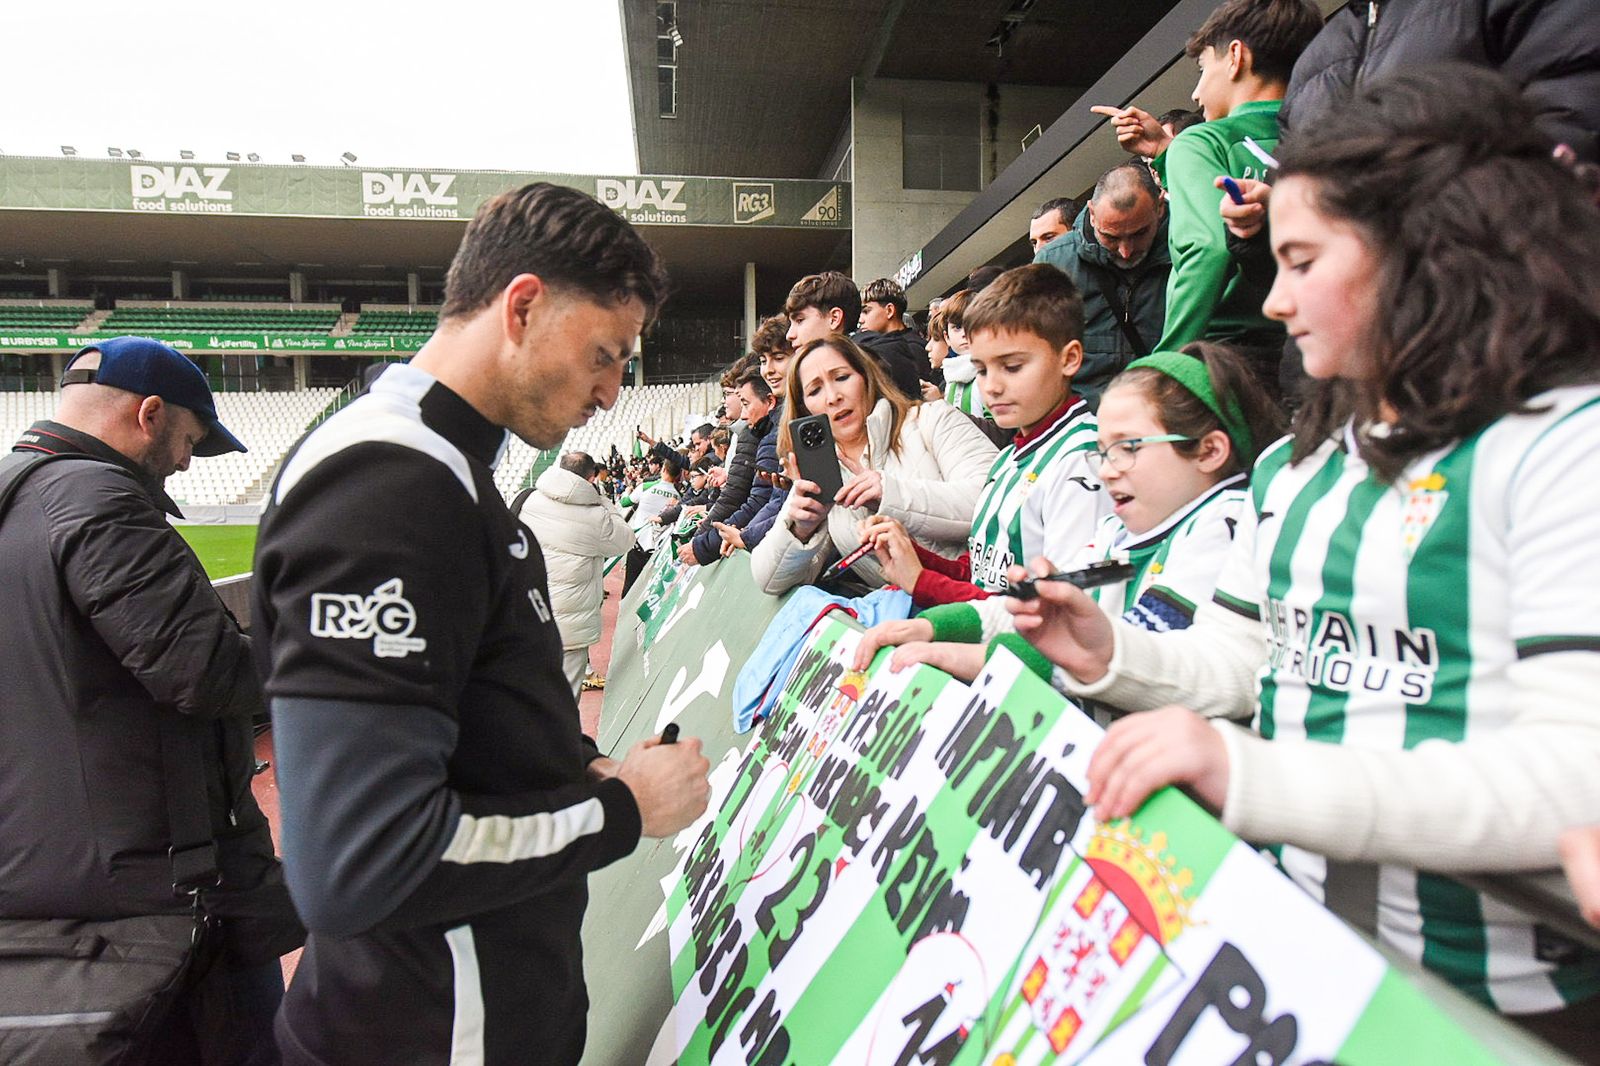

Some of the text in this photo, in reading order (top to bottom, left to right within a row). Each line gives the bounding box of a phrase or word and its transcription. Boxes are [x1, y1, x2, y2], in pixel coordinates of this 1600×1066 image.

[130, 165, 233, 200] DIAZ
[362, 172, 458, 205] DIAZ
[133, 198, 233, 212] food solutions
[597, 179, 687, 211] DIAZ
[738, 193, 769, 213] RG3
[363, 204, 458, 217] food solutions
[631, 211, 687, 223] solutions
[9, 337, 58, 346] URBYSER
[755, 832, 832, 973] 23
